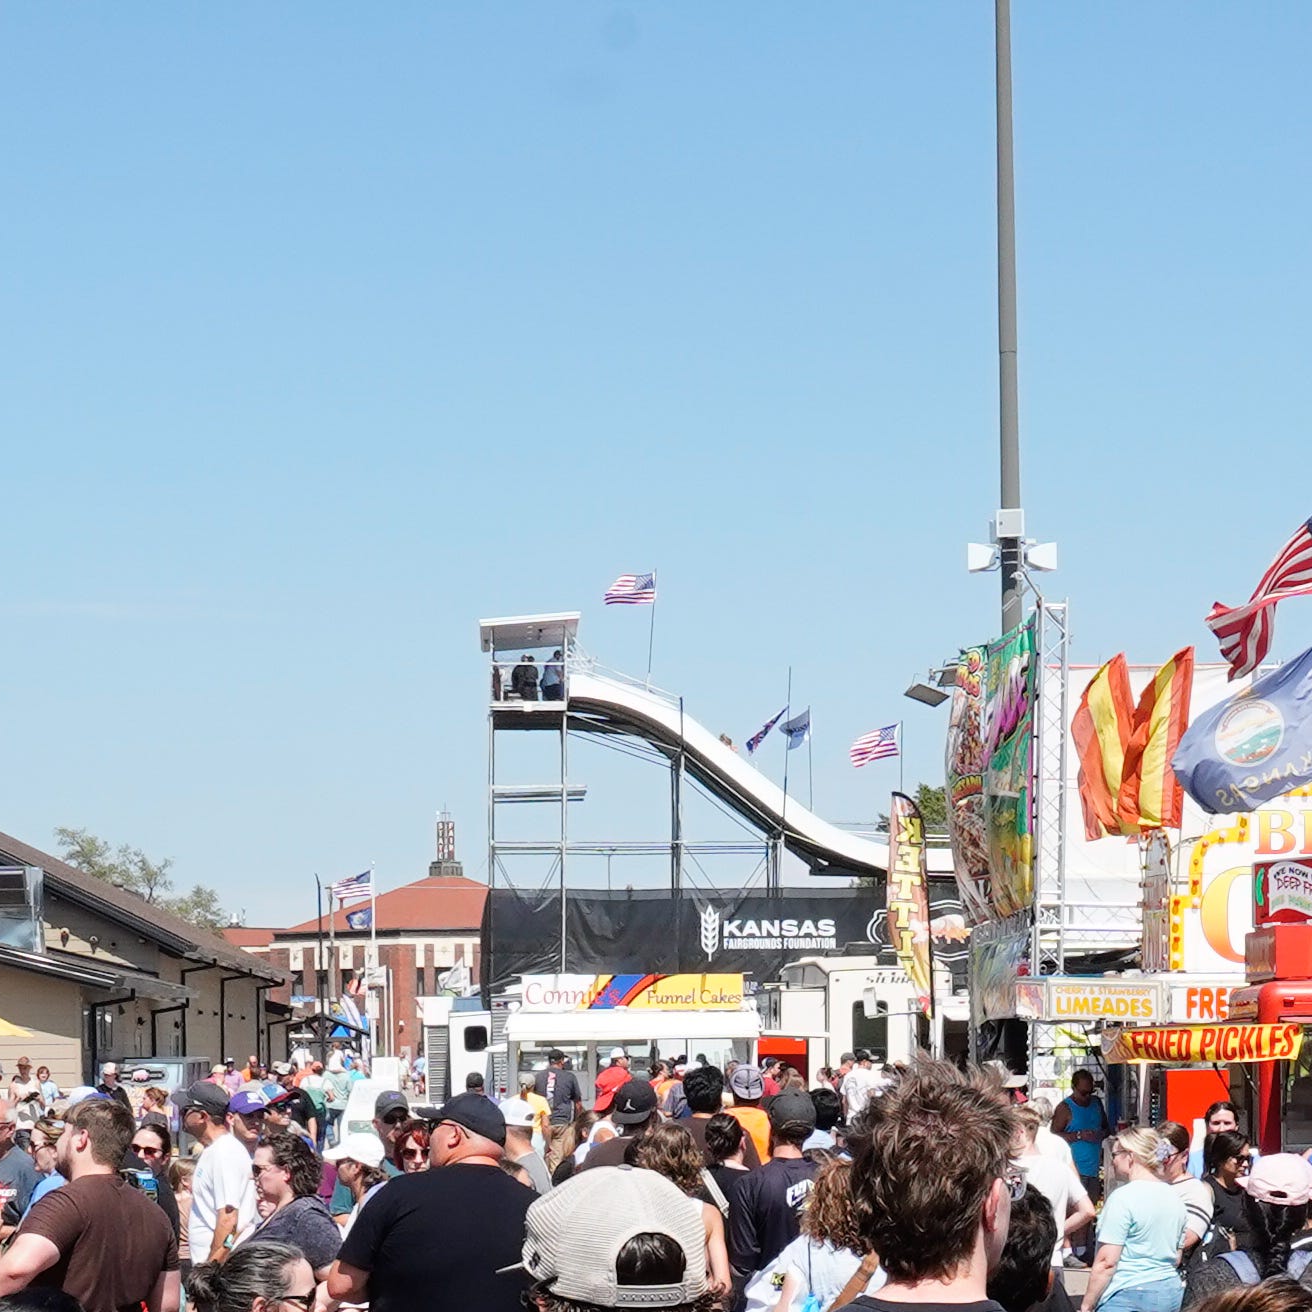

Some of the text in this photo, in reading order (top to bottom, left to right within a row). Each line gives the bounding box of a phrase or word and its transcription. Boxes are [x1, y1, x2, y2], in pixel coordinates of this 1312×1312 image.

[1289, 867, 1309, 879] NOW
[1277, 875, 1301, 890] DEEP
[723, 919, 836, 937] KANSAS
[724, 938, 837, 949] FAIRGROUNDS FOUNDATION
[525, 982, 741, 1005] Connie's Funnel Cakes
[1055, 997, 1153, 1017] LIMEADES
[1128, 1025, 1300, 1061] FRIED PICKLES
